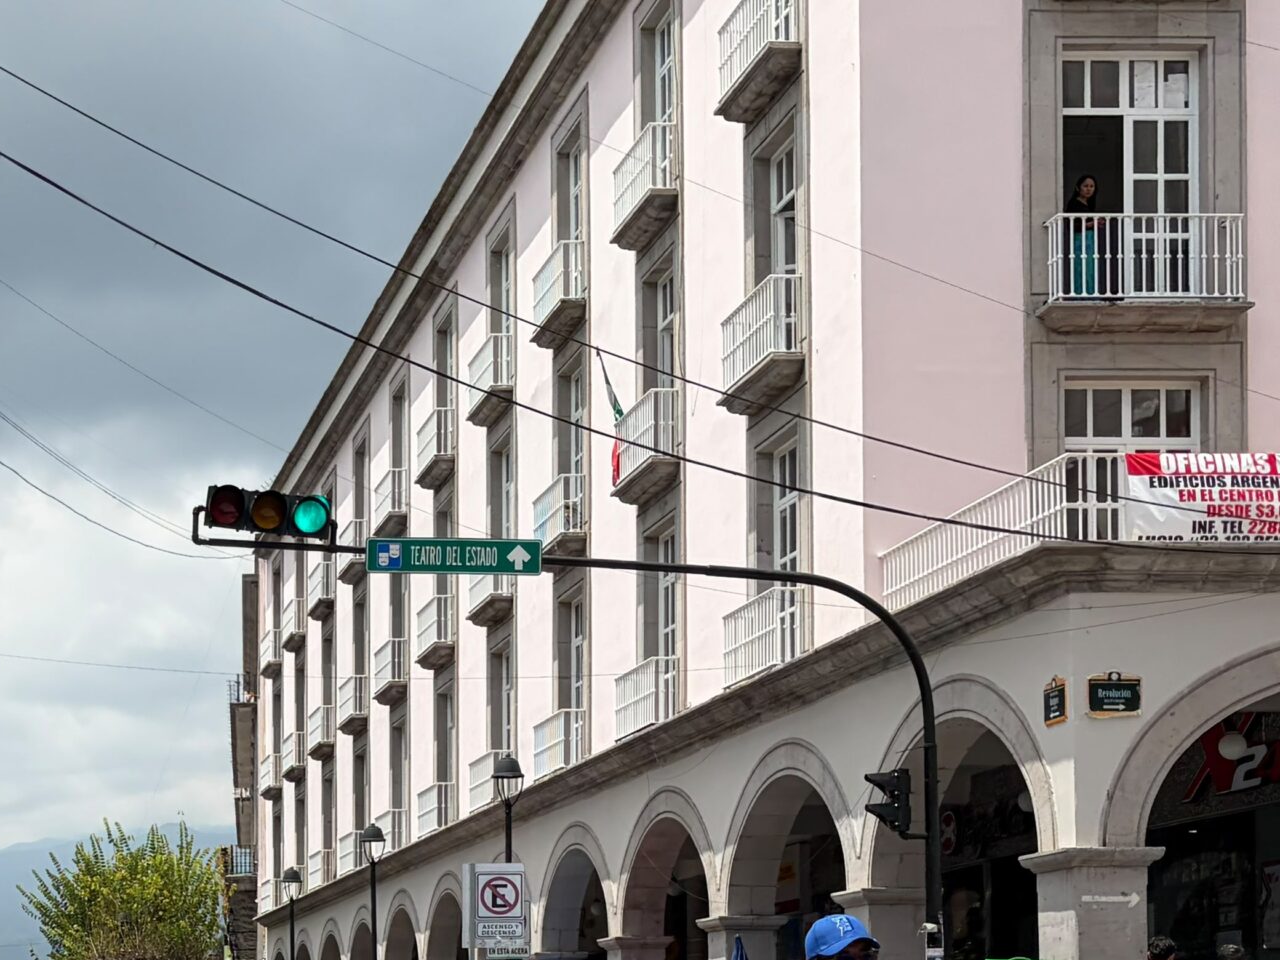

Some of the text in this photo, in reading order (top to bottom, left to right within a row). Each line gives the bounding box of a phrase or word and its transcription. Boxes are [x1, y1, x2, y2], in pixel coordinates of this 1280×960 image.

[1159, 452, 1271, 474] OFICINAS
[1149, 475, 1227, 489] EDIFICIOS
[1178, 489, 1274, 502] EN EL CENTRO
[1207, 504, 1251, 518] DESDE
[1192, 520, 1280, 535] INF. TEL 228
[410, 545, 498, 567] TEATRO DEL ESTADO
[1097, 688, 1132, 698] Revolución
[488, 947, 528, 955] EN ESTA ACERA
